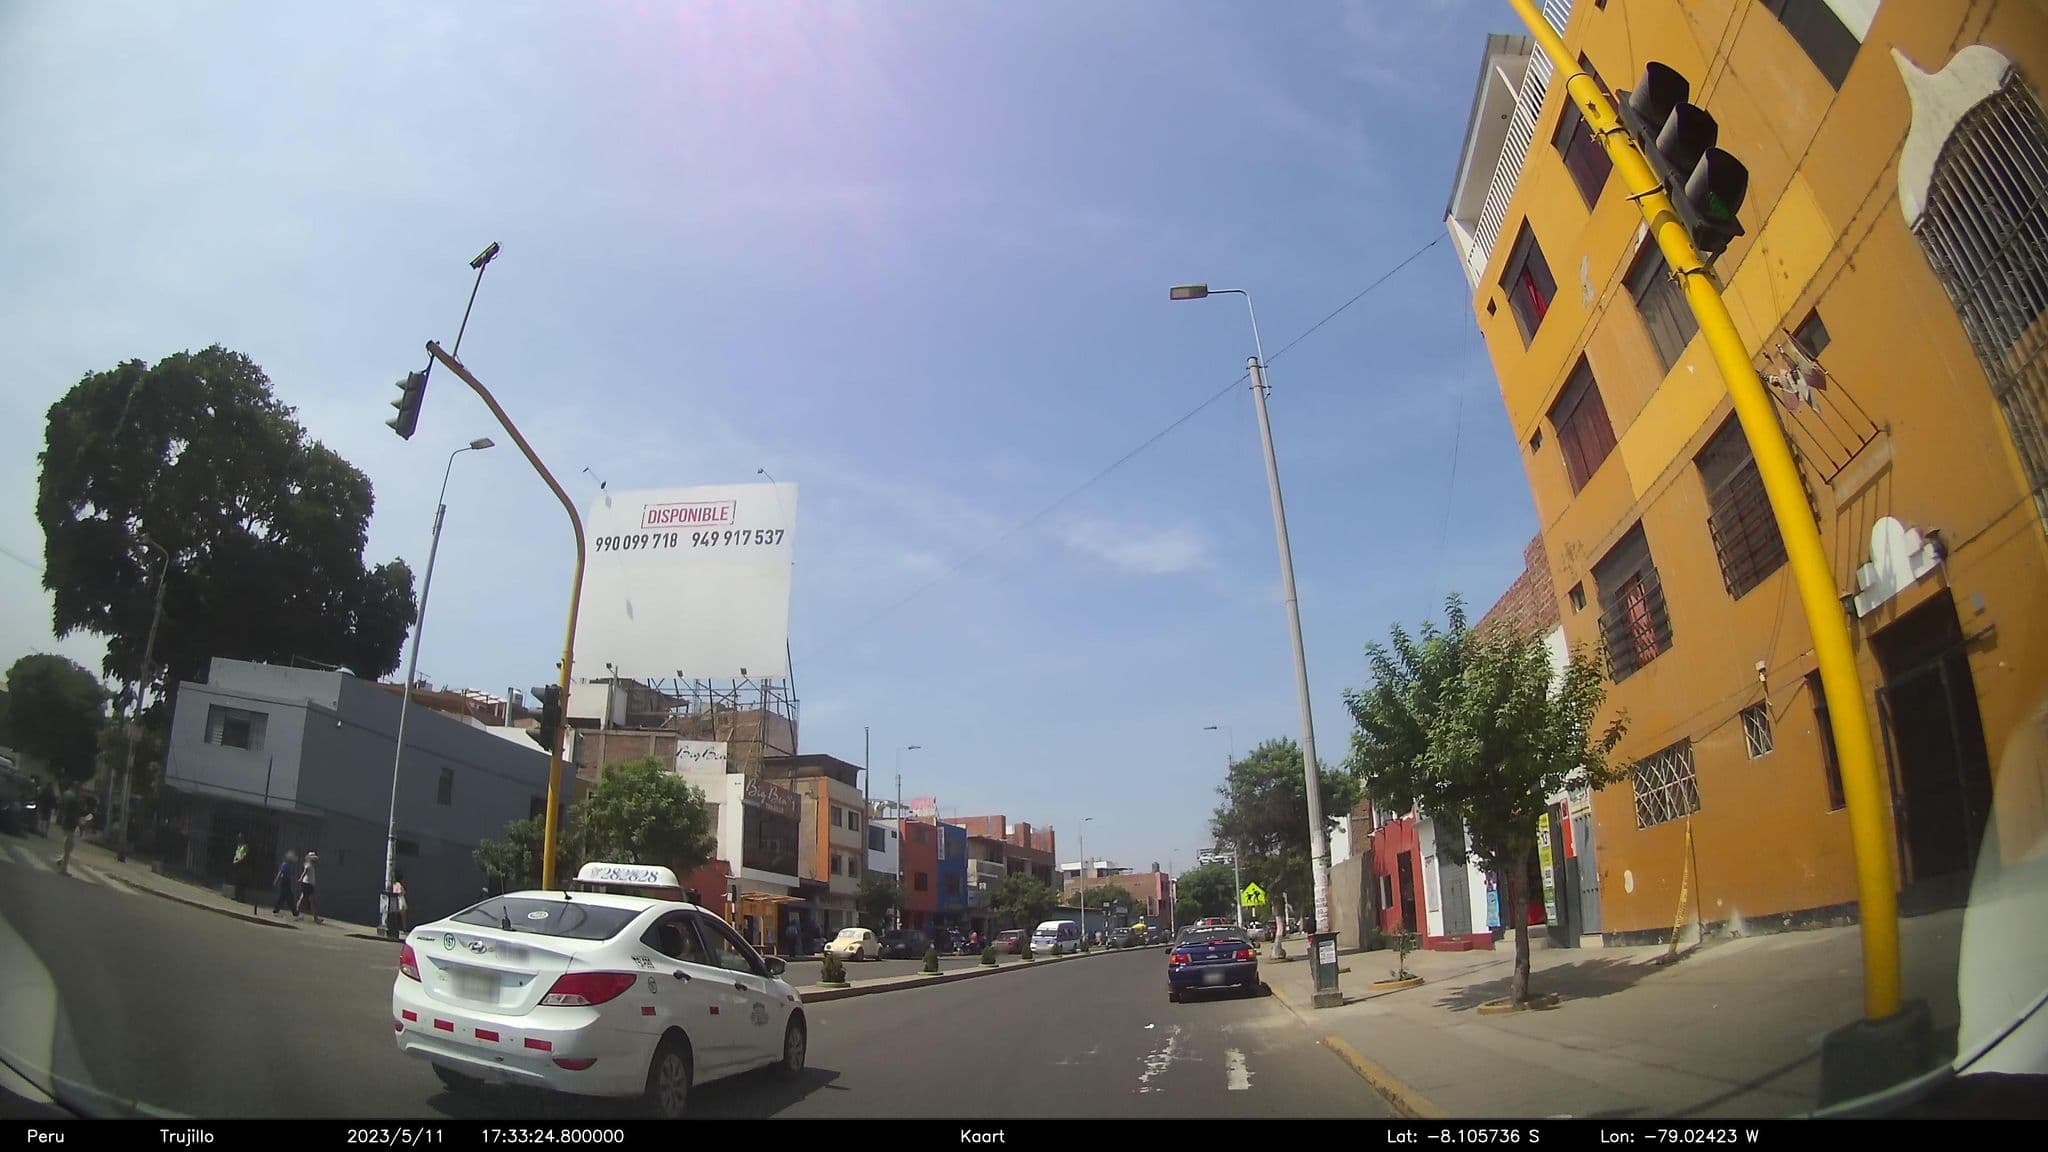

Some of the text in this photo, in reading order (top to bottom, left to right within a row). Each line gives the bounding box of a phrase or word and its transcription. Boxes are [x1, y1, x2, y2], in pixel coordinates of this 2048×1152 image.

[647, 506, 729, 524] DISPONIBLE
[596, 529, 785, 552] 990 099 718 949 917 537
[600, 868, 658, 883] 282828
